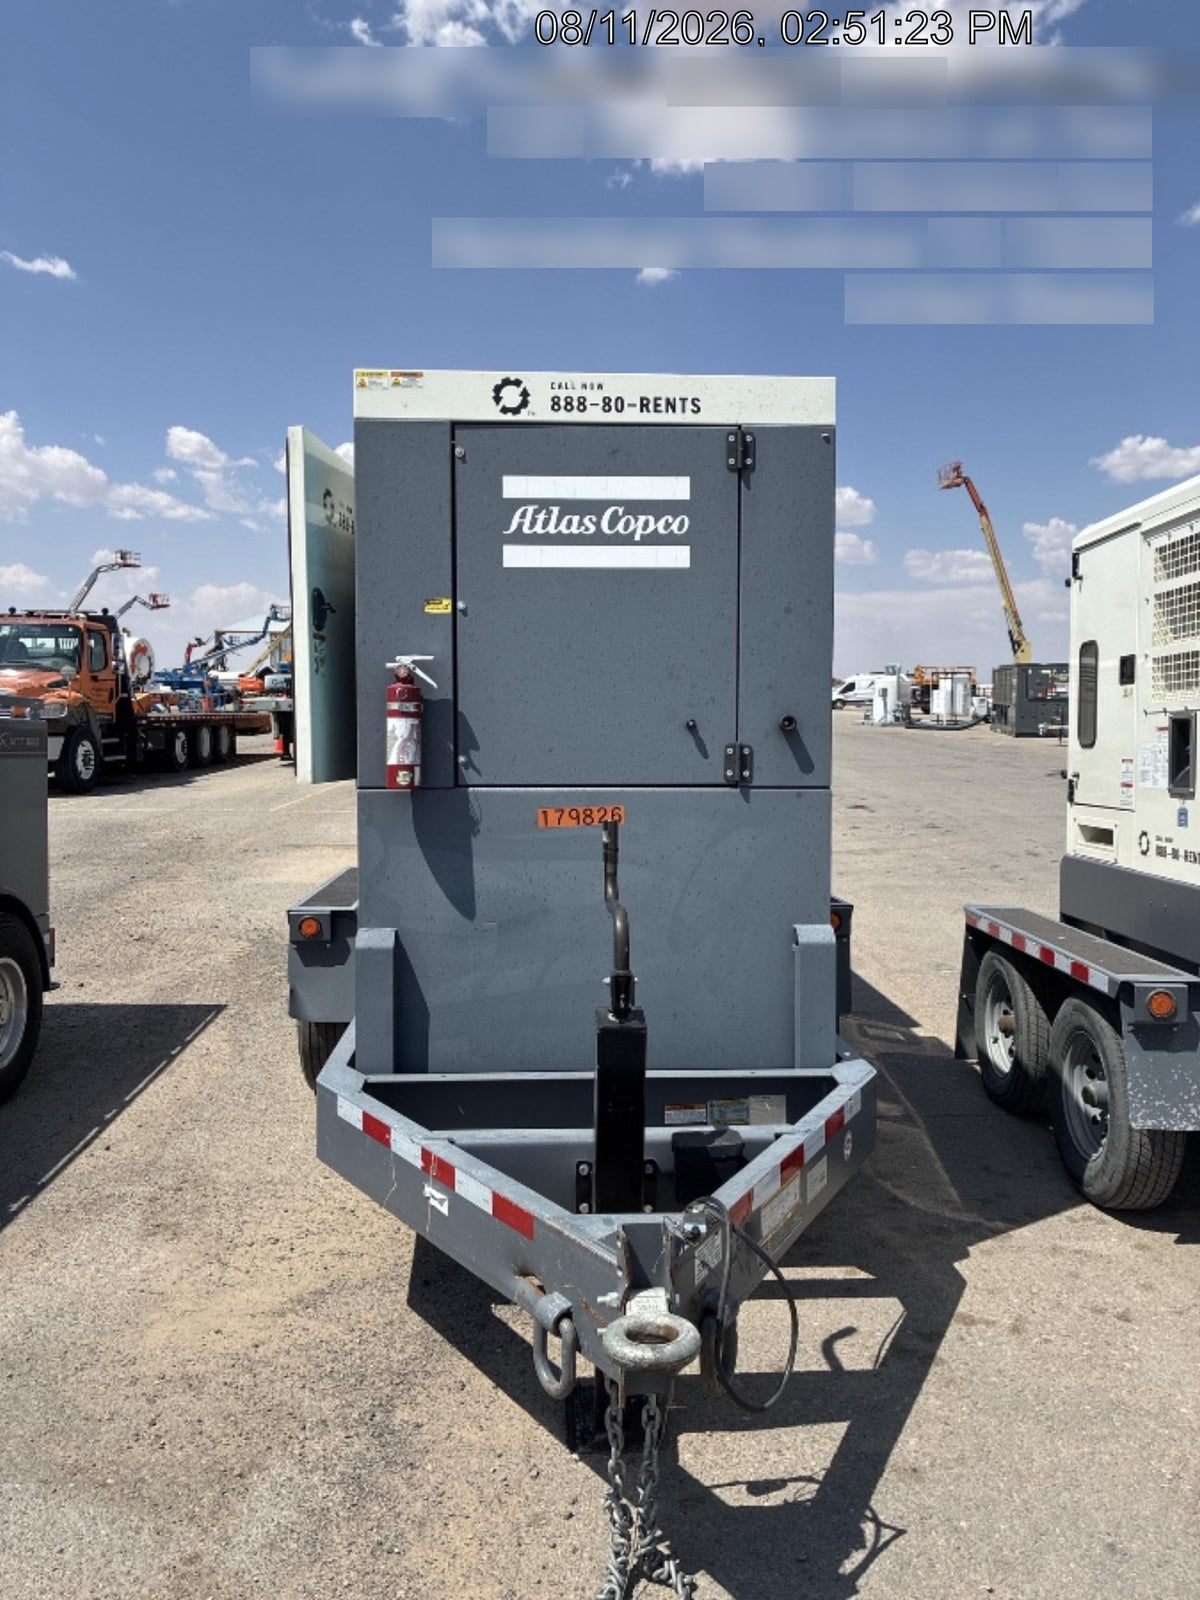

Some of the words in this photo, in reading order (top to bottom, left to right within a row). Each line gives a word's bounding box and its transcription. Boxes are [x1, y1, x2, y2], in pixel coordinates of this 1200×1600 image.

[550, 381, 576, 390] CALL
[581, 382, 604, 391] NOW
[550, 395, 702, 413] 888-80-RENTS
[502, 504, 598, 534] Atlas
[600, 506, 690, 541] Copco
[541, 806, 622, 827] 179826
